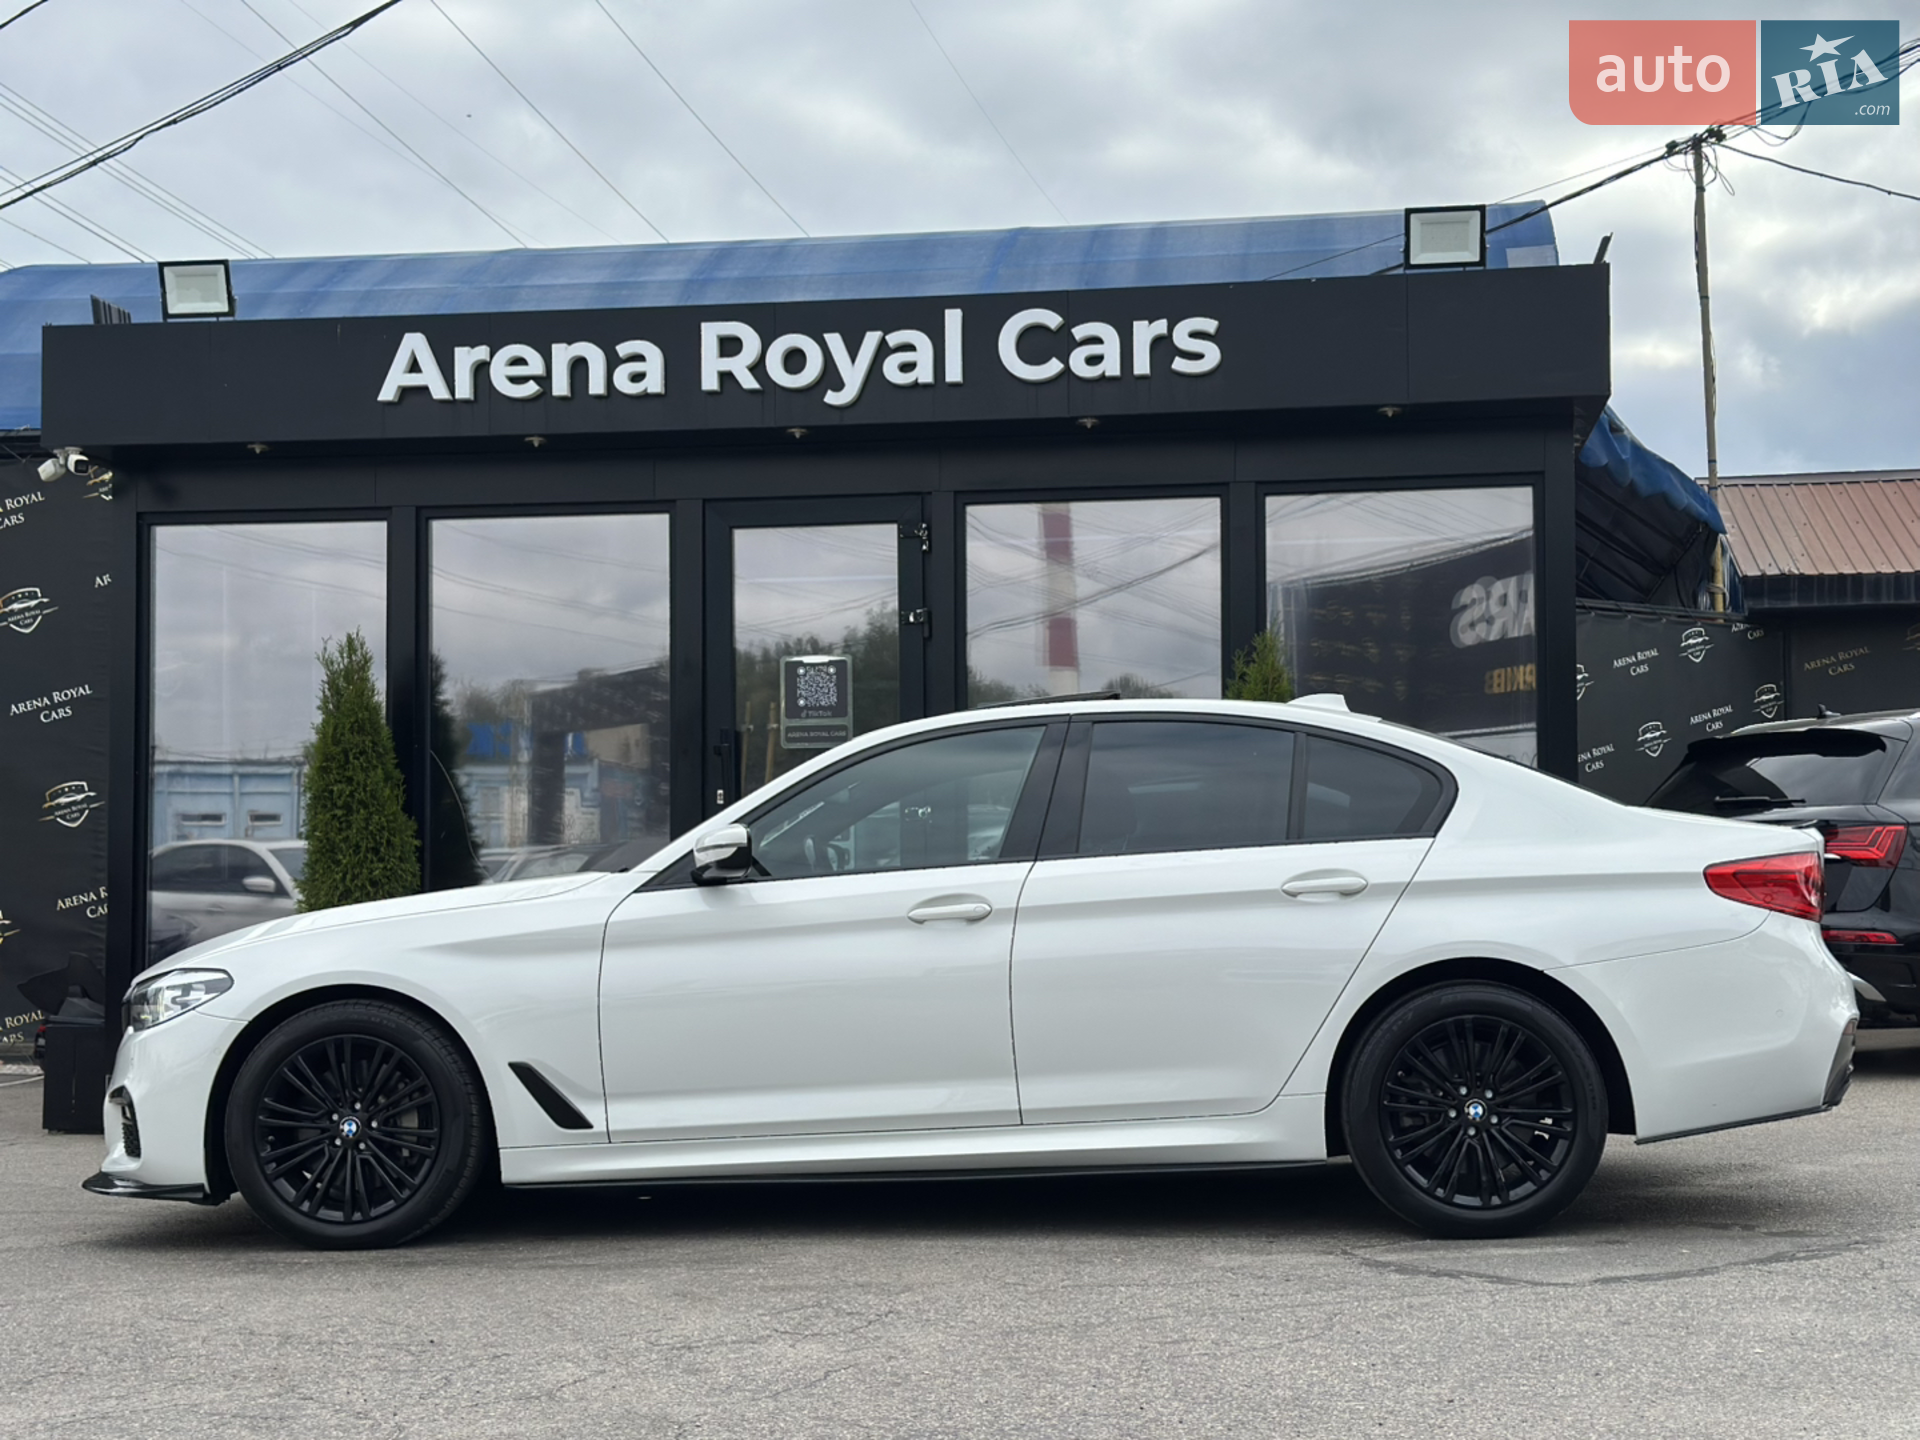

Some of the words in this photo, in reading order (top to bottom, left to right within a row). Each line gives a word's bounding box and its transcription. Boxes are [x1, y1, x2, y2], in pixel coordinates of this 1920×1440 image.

[377, 332, 664, 401] Arena
[701, 309, 963, 405] Royal
[998, 308, 1221, 380] Cars
[4, 491, 45, 510] ROYAL
[1613, 654, 1636, 668] ARENA
[1637, 648, 1659, 661] ROYAL
[1803, 656, 1837, 671] ARENA
[1838, 646, 1871, 661] ROYAL
[1630, 664, 1649, 676] CARS
[1828, 663, 1855, 676] CARS
[9, 696, 51, 716] ARENA
[52, 684, 93, 704] ROYAL
[39, 706, 73, 723] CARS
[1689, 712, 1712, 725] ARENA
[1706, 720, 1724, 732] CARS
[1585, 760, 1605, 773] CARS
[56, 891, 98, 911] ARENA
[4, 1009, 45, 1029] ROYAL
